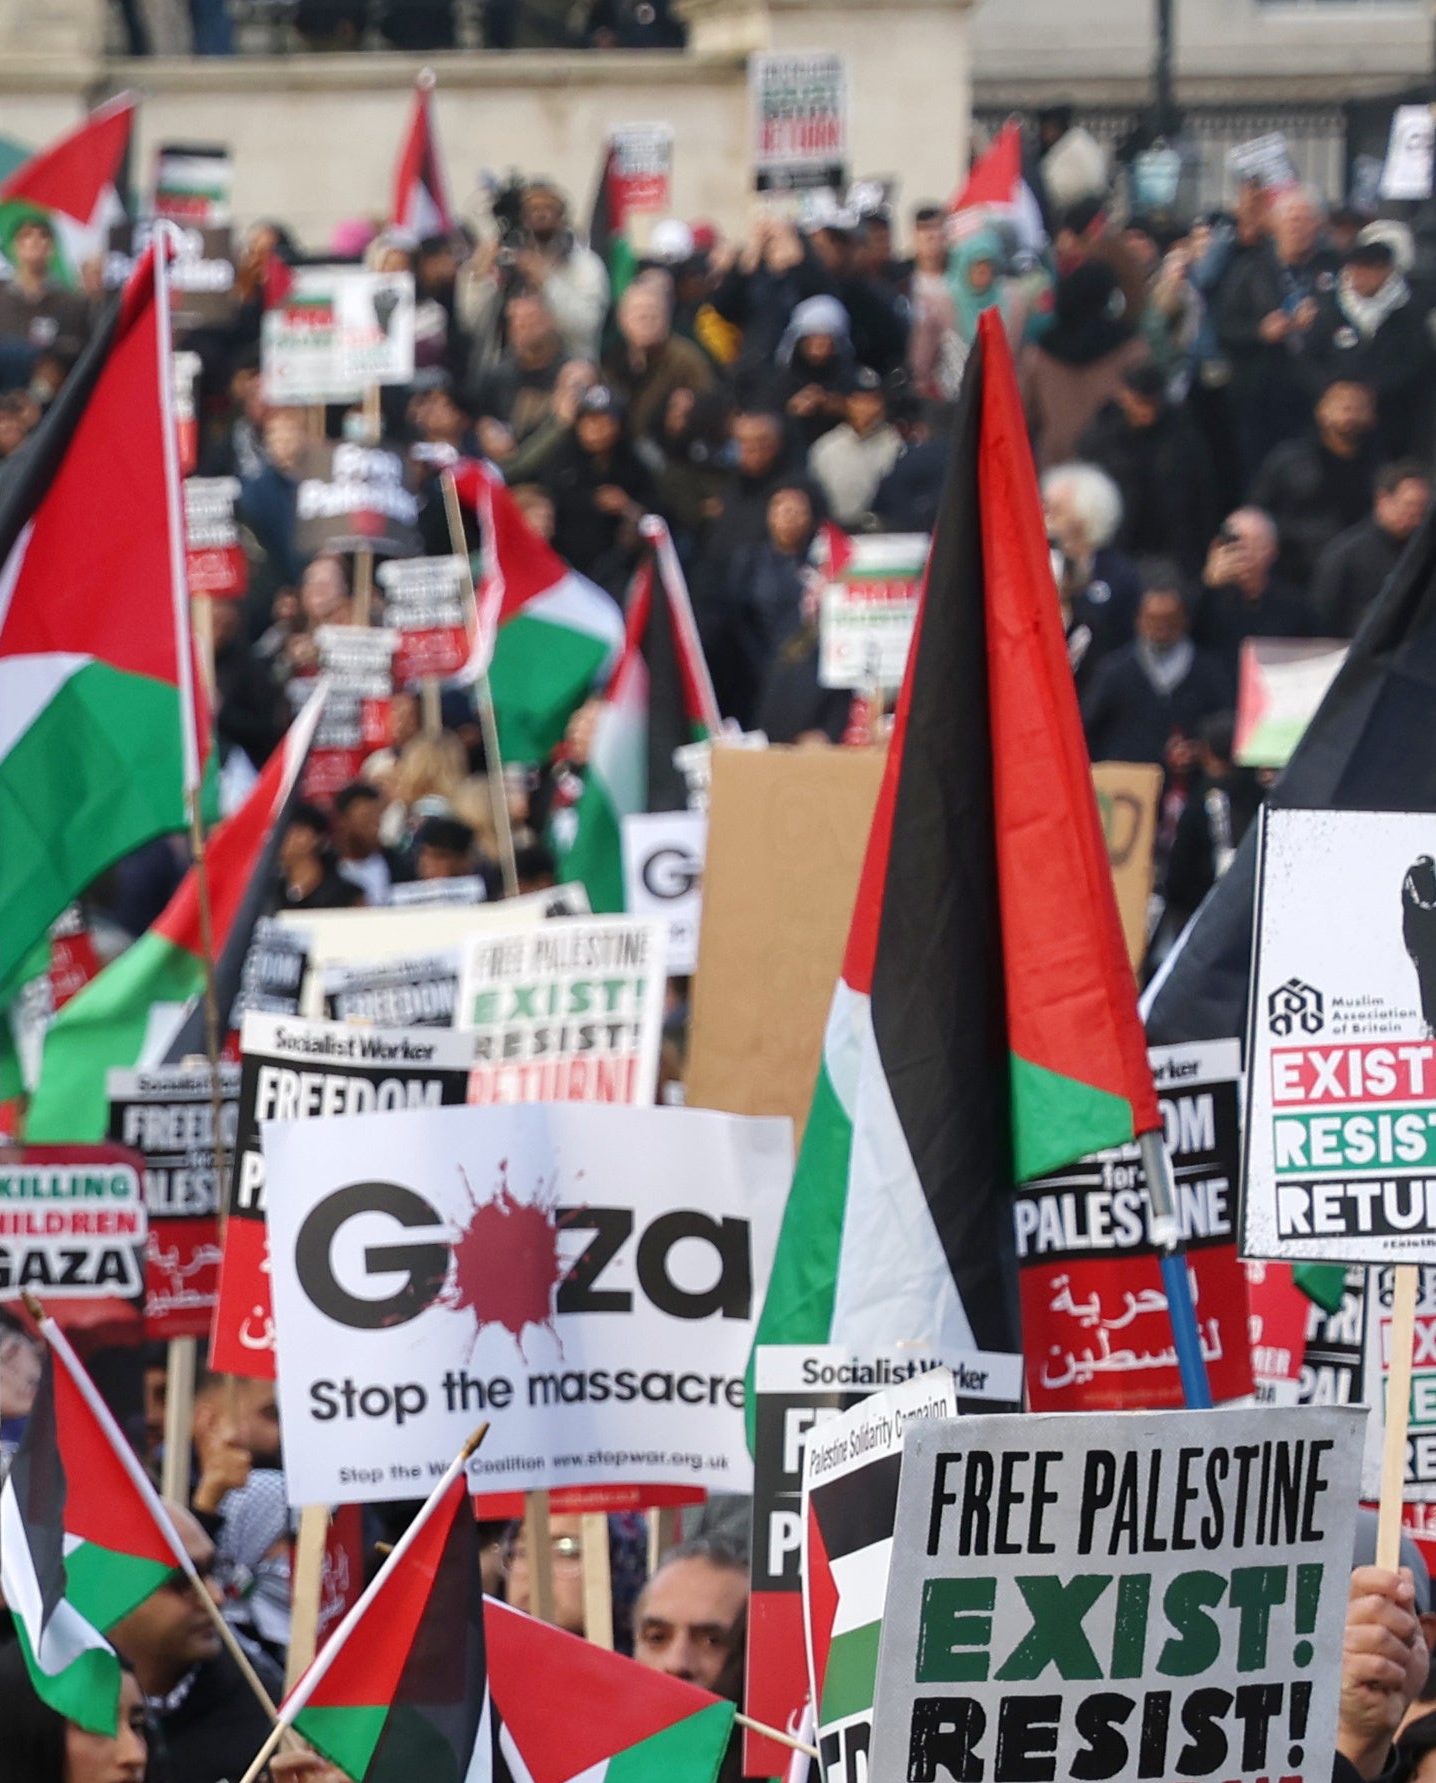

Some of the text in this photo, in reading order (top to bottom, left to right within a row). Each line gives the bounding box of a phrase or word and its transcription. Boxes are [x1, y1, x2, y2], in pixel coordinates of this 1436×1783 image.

[1101, 1161, 1141, 1189] for
[1275, 1113, 1436, 1168] RESIS
[1277, 1180, 1436, 1236] RETU
[294, 1180, 752, 1331] Gza
[310, 1368, 746, 1426] Stop the massacre
[927, 1439, 1334, 1556] FREE PALESTINE
[916, 1563, 1324, 1683] EXIST!
[907, 1682, 1312, 1783] RESIST!
